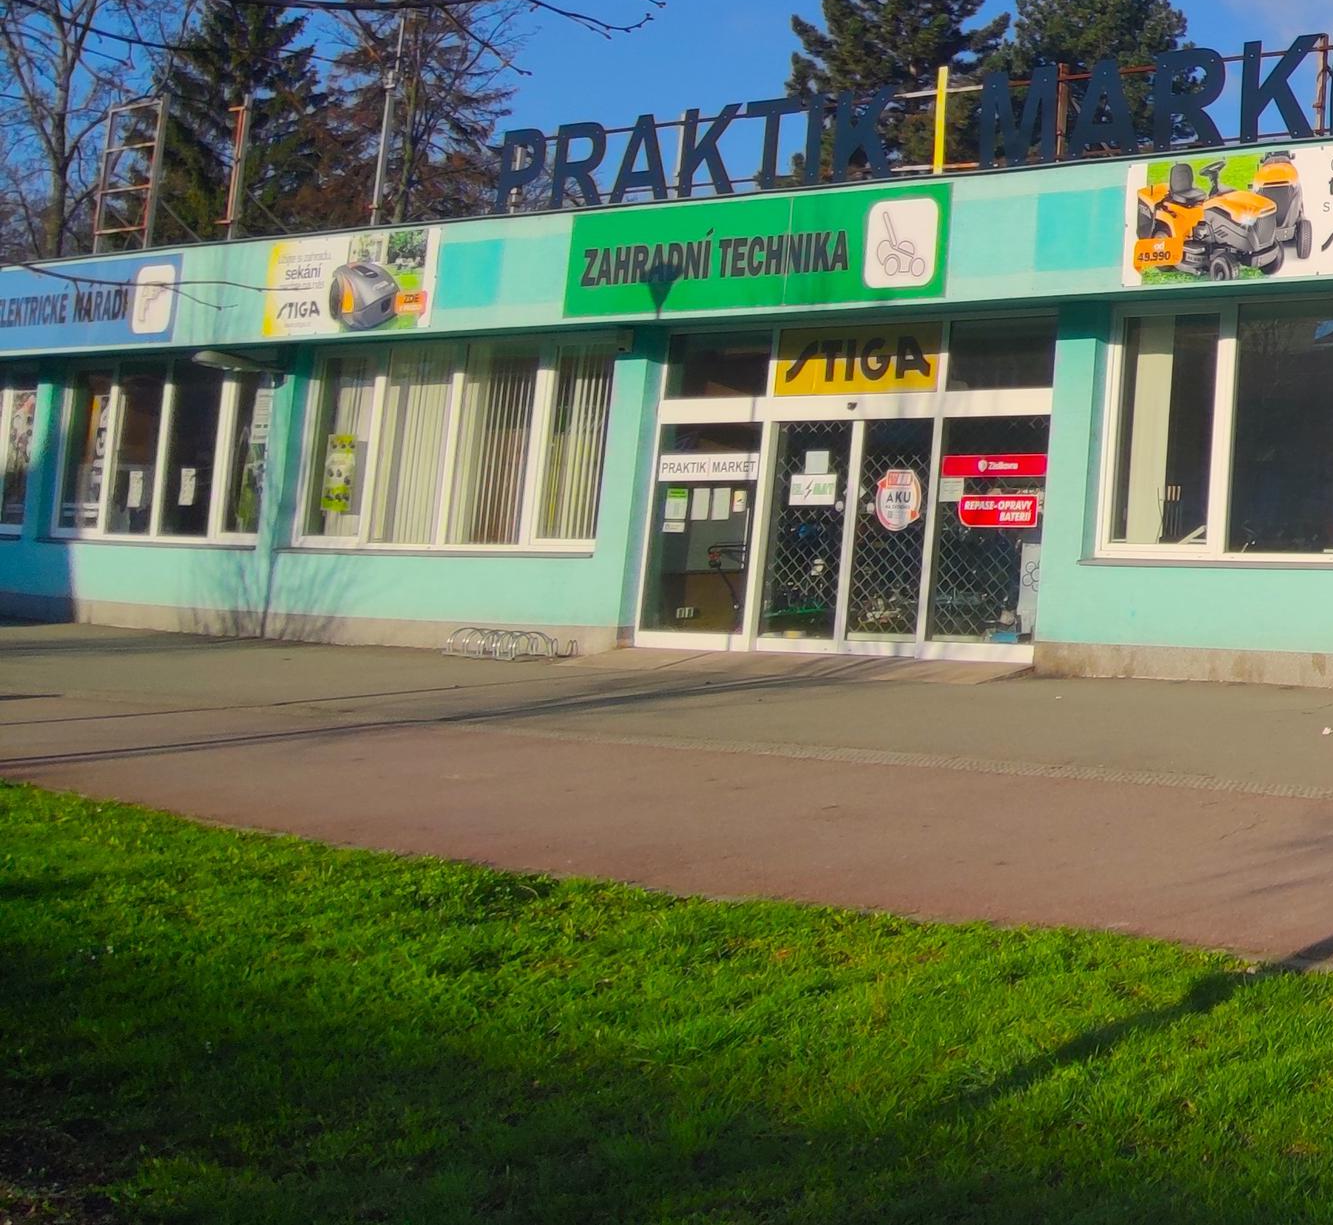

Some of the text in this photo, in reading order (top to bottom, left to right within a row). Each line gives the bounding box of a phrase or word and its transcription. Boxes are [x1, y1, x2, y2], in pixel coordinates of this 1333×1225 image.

[494, 85, 899, 214] PRAKTIK
[1322, 201, 1331, 213] s
[1153, 241, 1166, 251] od
[580, 227, 849, 287] ZAHRADNÍ TECHNIKA
[285, 263, 322, 281] sekání
[276, 300, 321, 320] STIGA
[785, 335, 932, 384] STIGA
[661, 460, 757, 474] PRAKTIK MARKET
[886, 490, 912, 503] AKU
